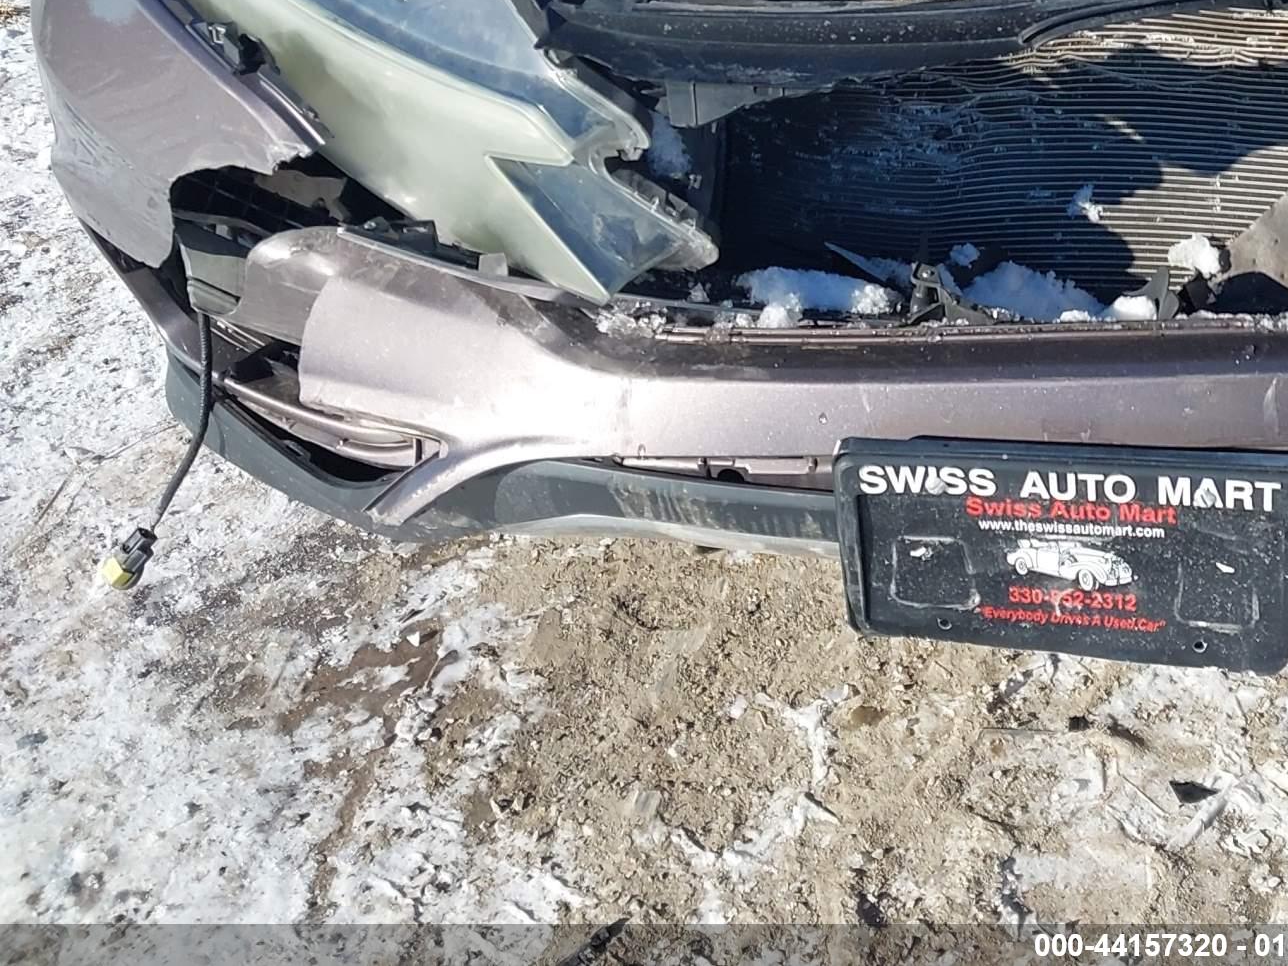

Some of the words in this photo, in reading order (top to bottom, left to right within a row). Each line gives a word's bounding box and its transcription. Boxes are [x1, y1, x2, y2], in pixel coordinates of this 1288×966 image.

[859, 465, 997, 496] SWISS
[1020, 470, 1137, 504] AUTO
[1157, 475, 1282, 512] MART
[965, 495, 1043, 518] Swiss
[1051, 500, 1111, 521] Auto
[1119, 503, 1177, 524] Mart
[978, 519, 1165, 539] www.theswissautomart.com
[1050, 611, 1090, 626] Drives
[1091, 614, 1102, 626] A
